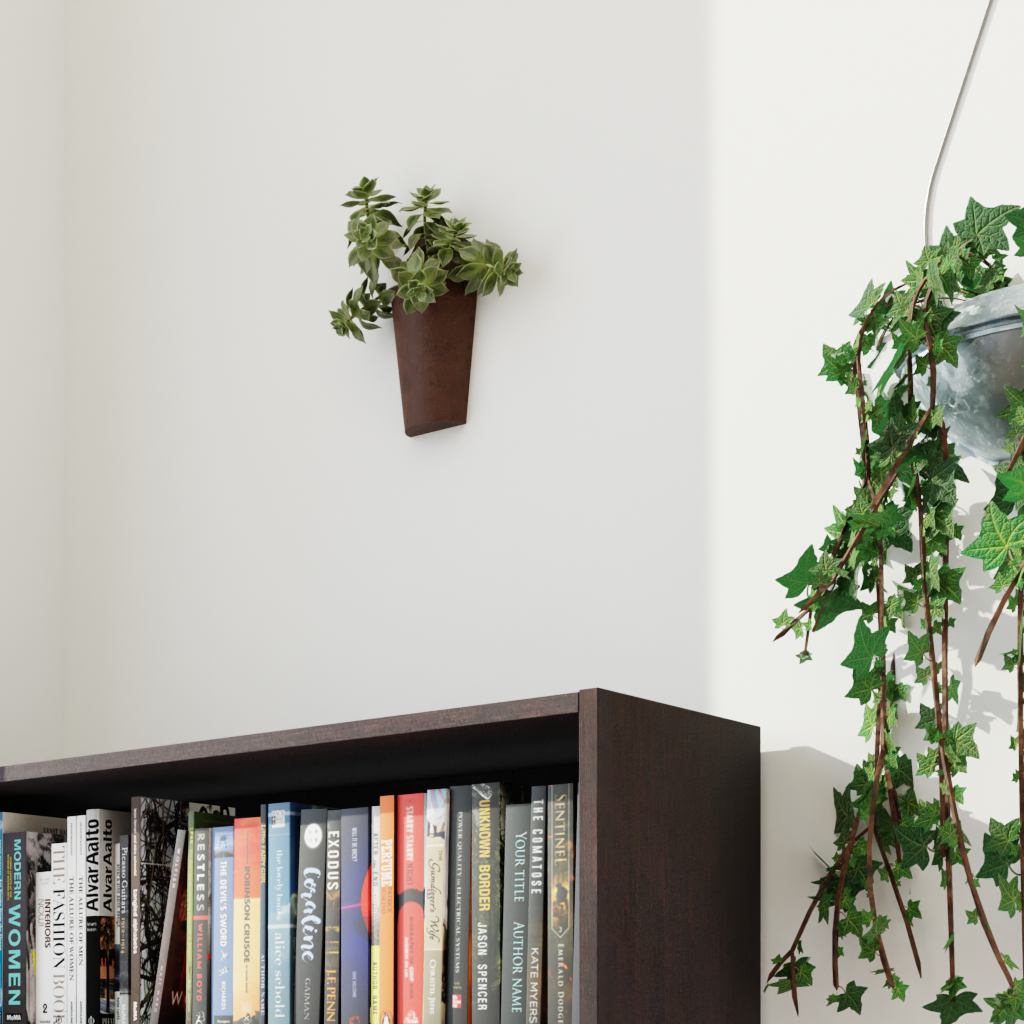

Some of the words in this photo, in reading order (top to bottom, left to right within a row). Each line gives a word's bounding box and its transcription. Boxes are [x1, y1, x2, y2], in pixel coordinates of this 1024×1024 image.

[406, 806, 414, 833] STARRY
[479, 799, 490, 858] UNKNOWN
[532, 799, 544, 821] THE
[554, 794, 568, 866] SENTINEL
[53, 846, 65, 885] THE
[172, 848, 181, 889] WOLFISH
[327, 831, 340, 890] EXODUS
[381, 839, 393, 887] PERFUME
[406, 835, 414, 861] STARRY
[455, 841, 463, 877] QUALITY
[514, 831, 528, 867] YOUR
[531, 828, 543, 895] COMATOSE
[13, 839, 21, 900] MODERN
[196, 833, 205, 911] RESTLESS
[274, 866, 283, 891] lovely
[479, 865, 490, 911] BORDER
[514, 870, 525, 902] TITLE
[53, 890, 65, 968] FASHION
[219, 914, 227, 947] SWORD
[300, 867, 322, 964] Coraline
[8, 904, 21, 1005] WOMEN
[274, 932, 285, 966] alice
[477, 922, 488, 955] JASON
[512, 921, 525, 973] AUTHOR
[325, 970, 336, 984] J.F.
[530, 947, 539, 978] KATE
[557, 943, 565, 986] EMERALD
[274, 970, 285, 1018] sebold
[303, 978, 311, 1020] GAIMAN
[326, 987, 336, 1022] PENN
[428, 998, 436, 1014] JEFFS
[477, 964, 487, 1010] SPENCER
[511, 978, 523, 1013] NAME
[528, 982, 538, 1024] MYERS
